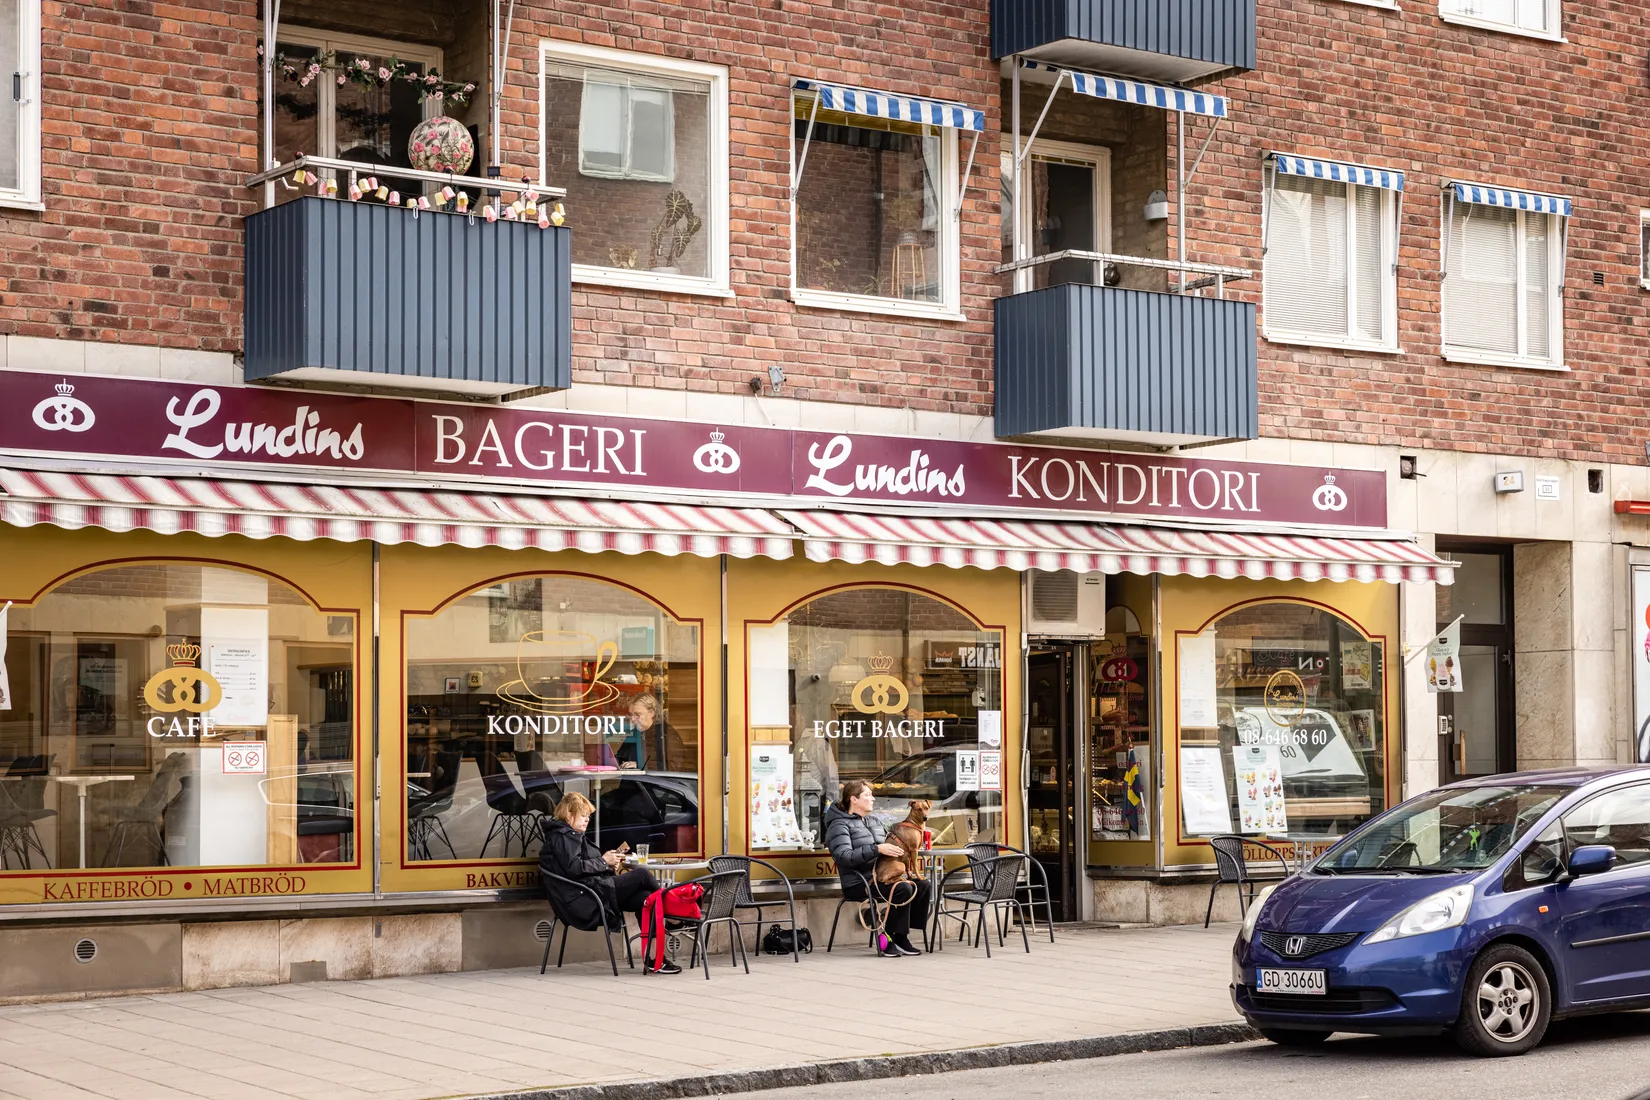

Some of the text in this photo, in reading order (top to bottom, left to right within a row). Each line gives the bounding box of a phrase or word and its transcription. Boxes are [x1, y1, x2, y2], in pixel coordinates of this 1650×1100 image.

[161, 388, 647, 477] Lundins BAGERI
[803, 435, 1262, 513] Lundins KONDITORI
[1503, 476, 1515, 486] 24
[487, 715, 626, 736] KONDITORI
[813, 720, 945, 738] EGET BAGERI
[1245, 729, 1327, 745] 08-646 68 60
[43, 873, 306, 900] KAFFEBRÖD MATBRÖD
[1263, 971, 1323, 989] GD 3066U
